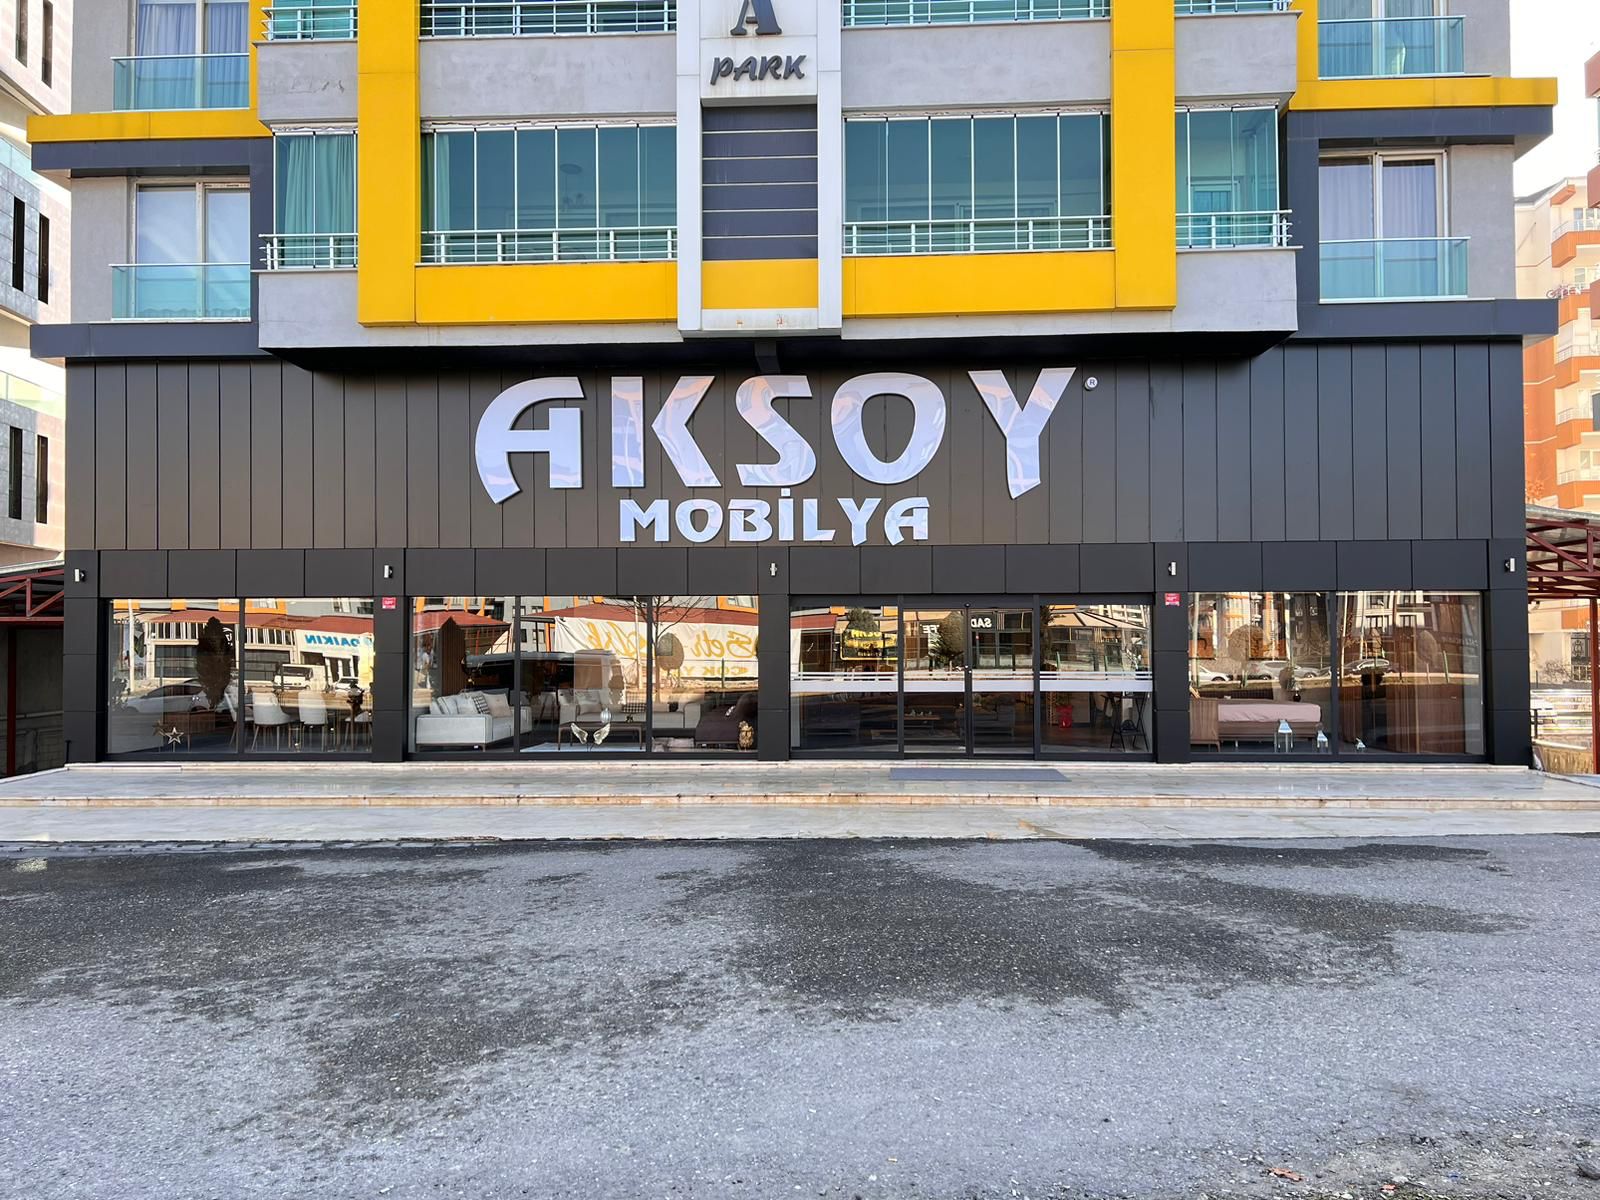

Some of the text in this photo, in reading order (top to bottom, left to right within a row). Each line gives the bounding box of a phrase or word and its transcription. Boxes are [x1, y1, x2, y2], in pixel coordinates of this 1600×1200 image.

[730, 0, 782, 36] A
[710, 55, 806, 86] PARK
[475, 367, 1077, 504] AKSOY
[619, 487, 930, 547] MOBİLYA
